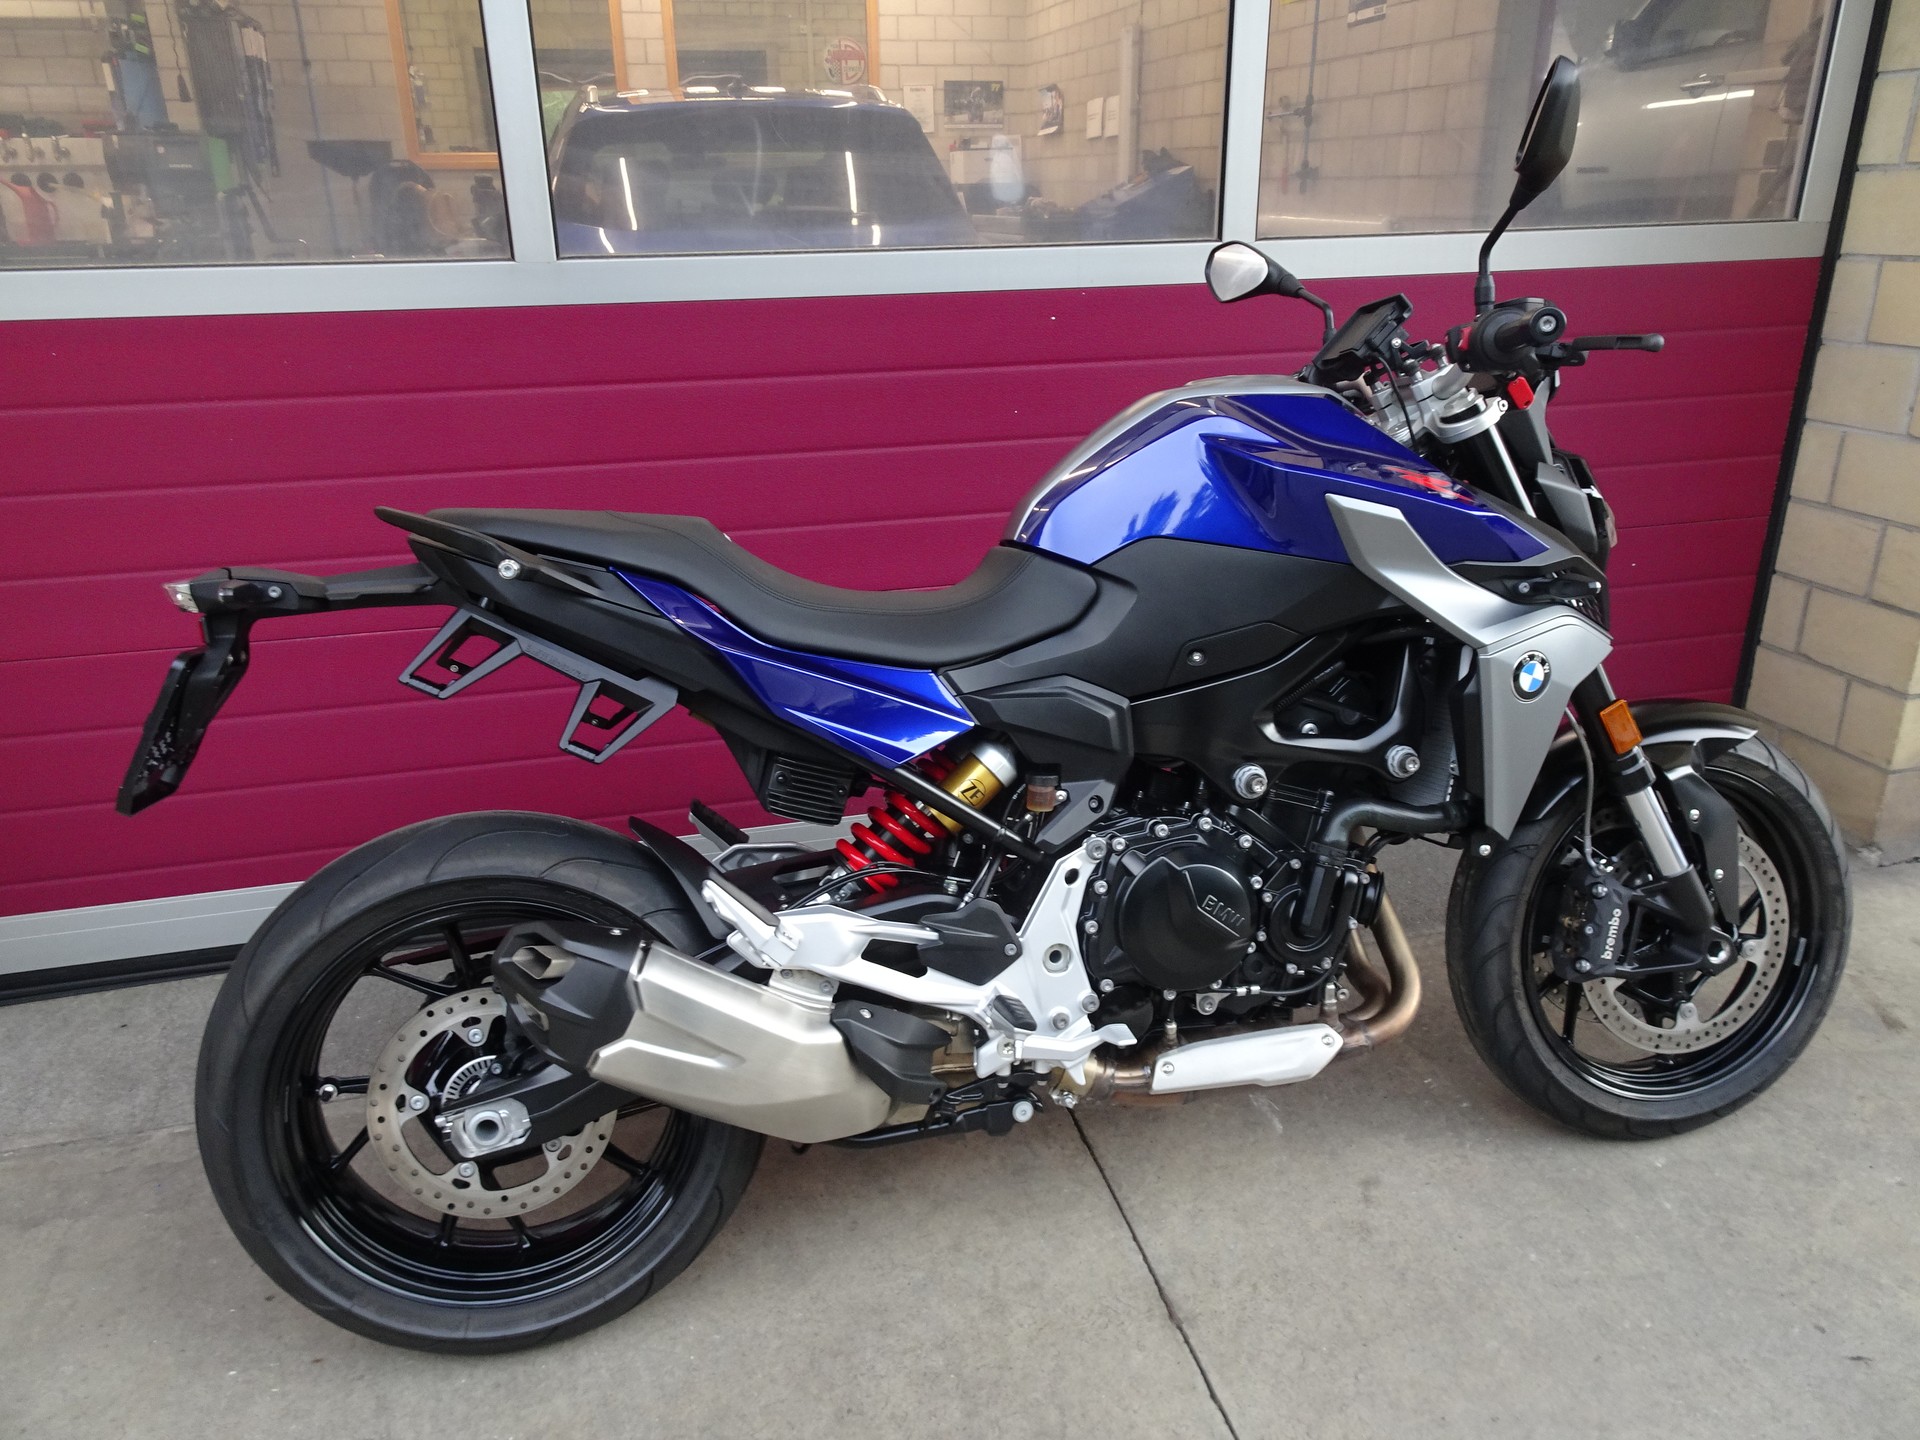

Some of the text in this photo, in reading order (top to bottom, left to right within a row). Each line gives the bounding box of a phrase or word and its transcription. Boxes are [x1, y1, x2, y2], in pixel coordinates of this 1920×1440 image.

[959, 779, 986, 807] ZF
[1201, 894, 1246, 927] BMW
[1600, 908, 1622, 960] brembo
